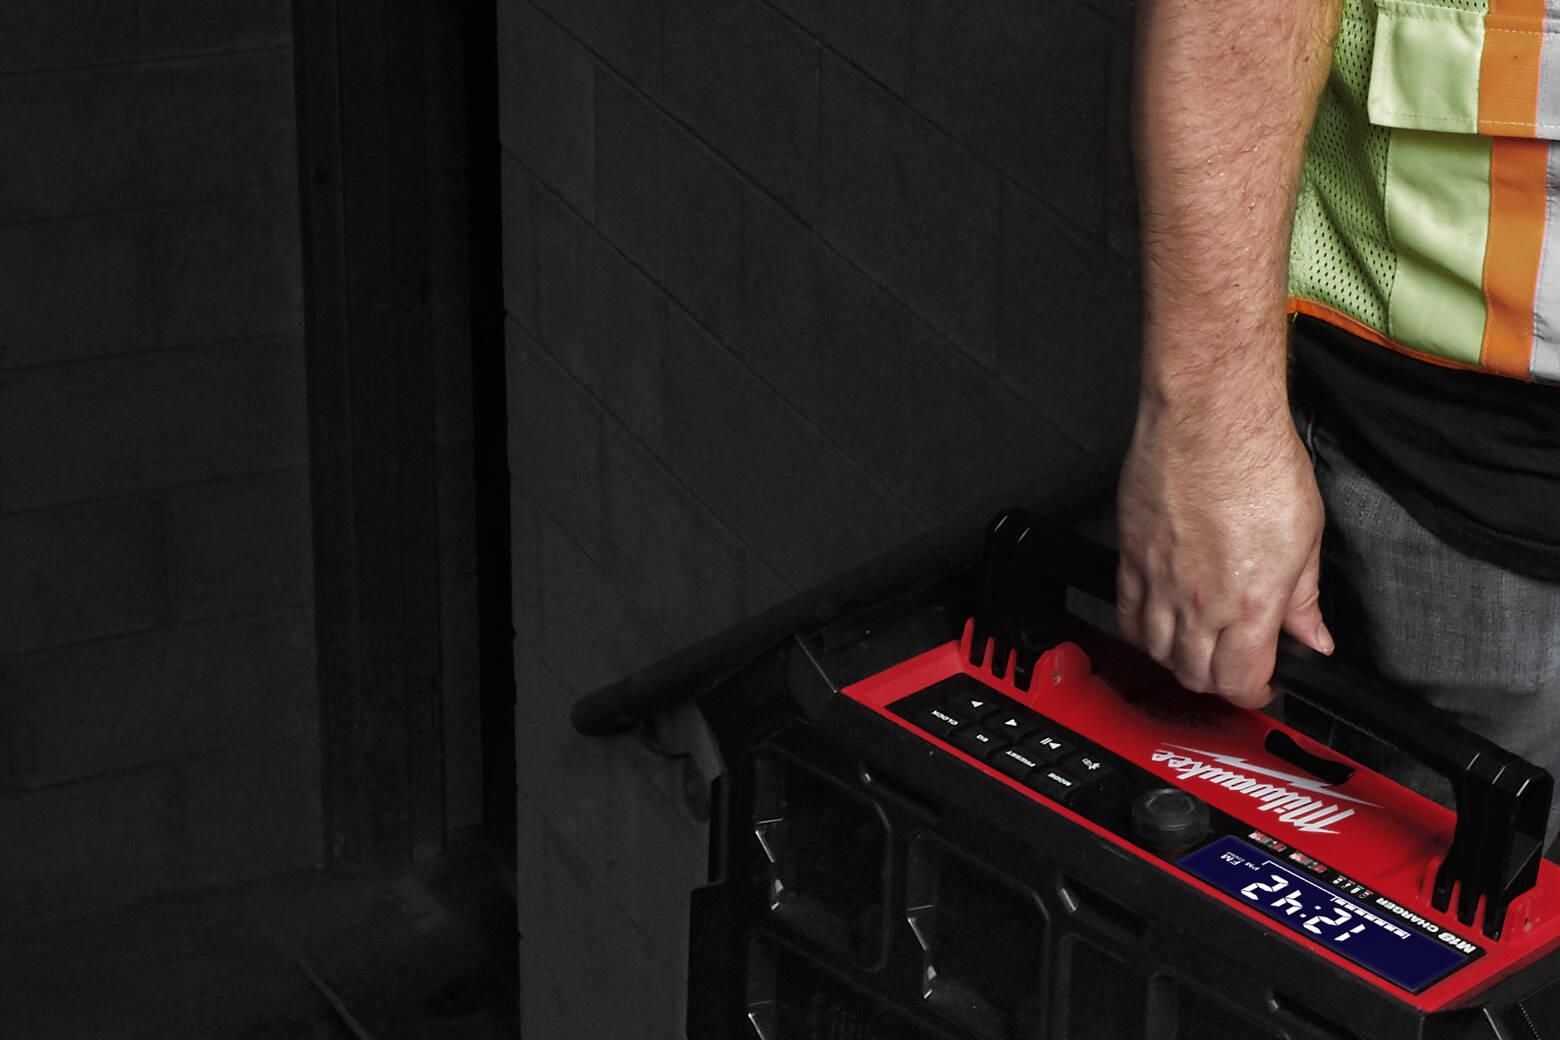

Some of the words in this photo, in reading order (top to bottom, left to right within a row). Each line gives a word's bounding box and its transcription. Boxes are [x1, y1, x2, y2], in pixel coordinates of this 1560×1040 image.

[930, 709, 959, 726] CLOCK
[1005, 750, 1036, 768] PRESET
[1047, 772, 1073, 787] MODE
[1151, 751, 1356, 834] Milwaukee
[1220, 852, 1240, 866] FM
[1241, 873, 1366, 942] 12:42
[1376, 897, 1439, 933] CHARGER
[1438, 931, 1476, 953] M18
